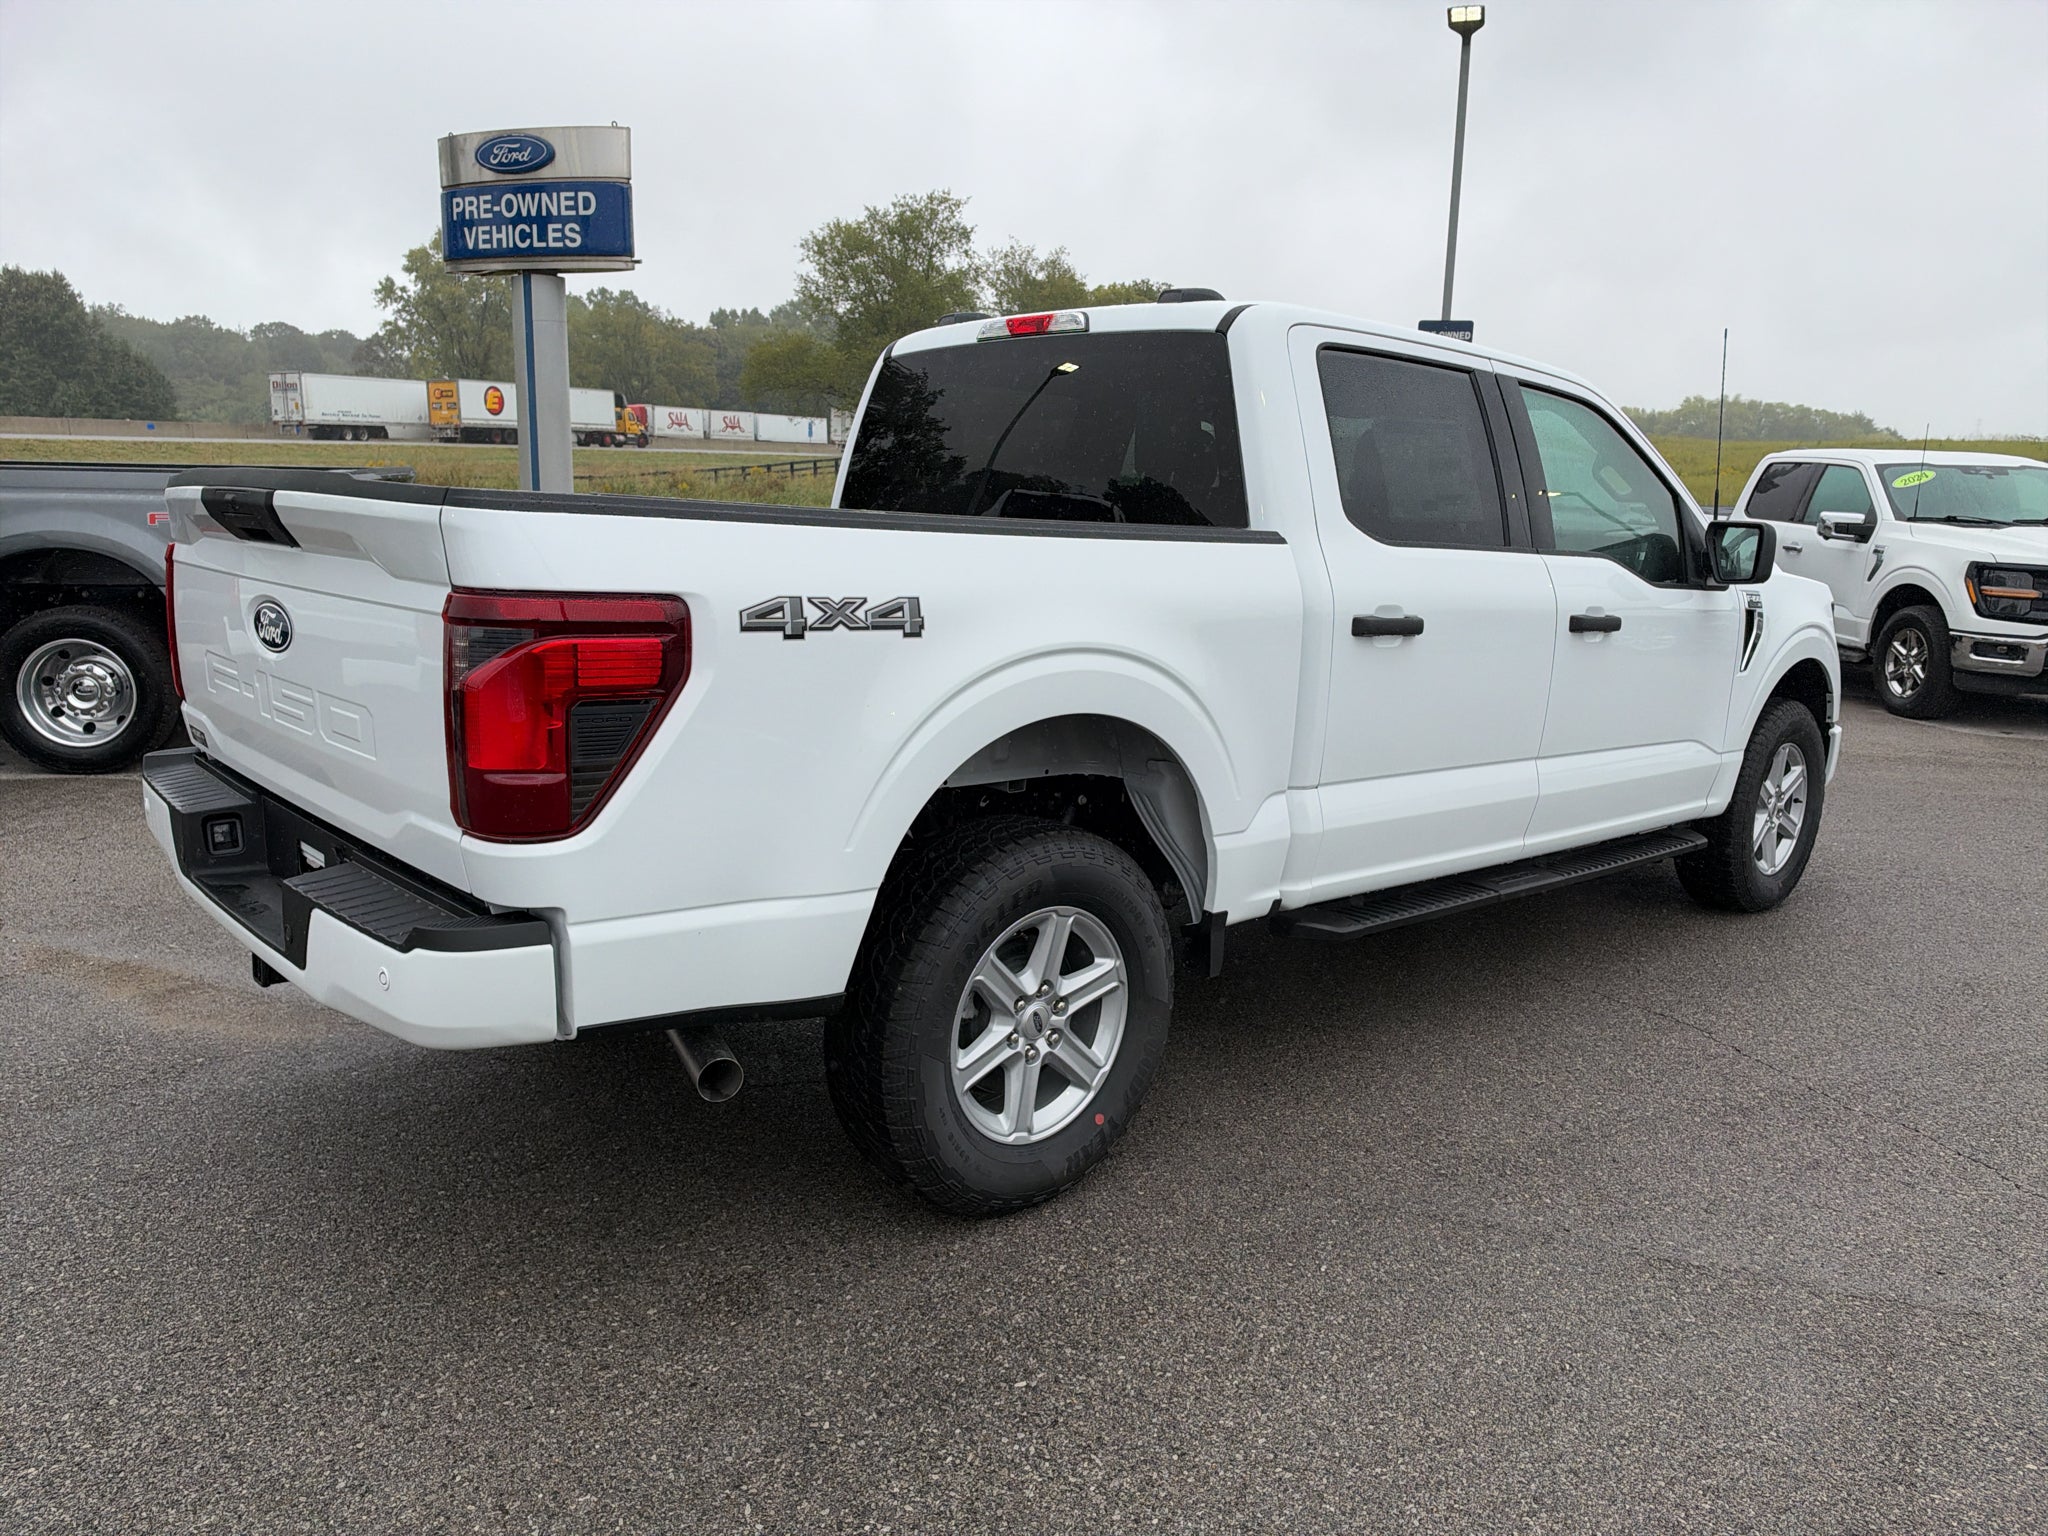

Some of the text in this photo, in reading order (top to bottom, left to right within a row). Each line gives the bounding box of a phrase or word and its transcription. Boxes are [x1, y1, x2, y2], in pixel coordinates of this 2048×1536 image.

[490, 143, 532, 165] Ford
[452, 191, 597, 221] PRE-OWNED
[464, 223, 582, 250] VEHICLES
[667, 411, 693, 431] SAIA
[722, 415, 745, 433] SAIA
[258, 608, 283, 645] Ford
[204, 649, 377, 761] F-150
